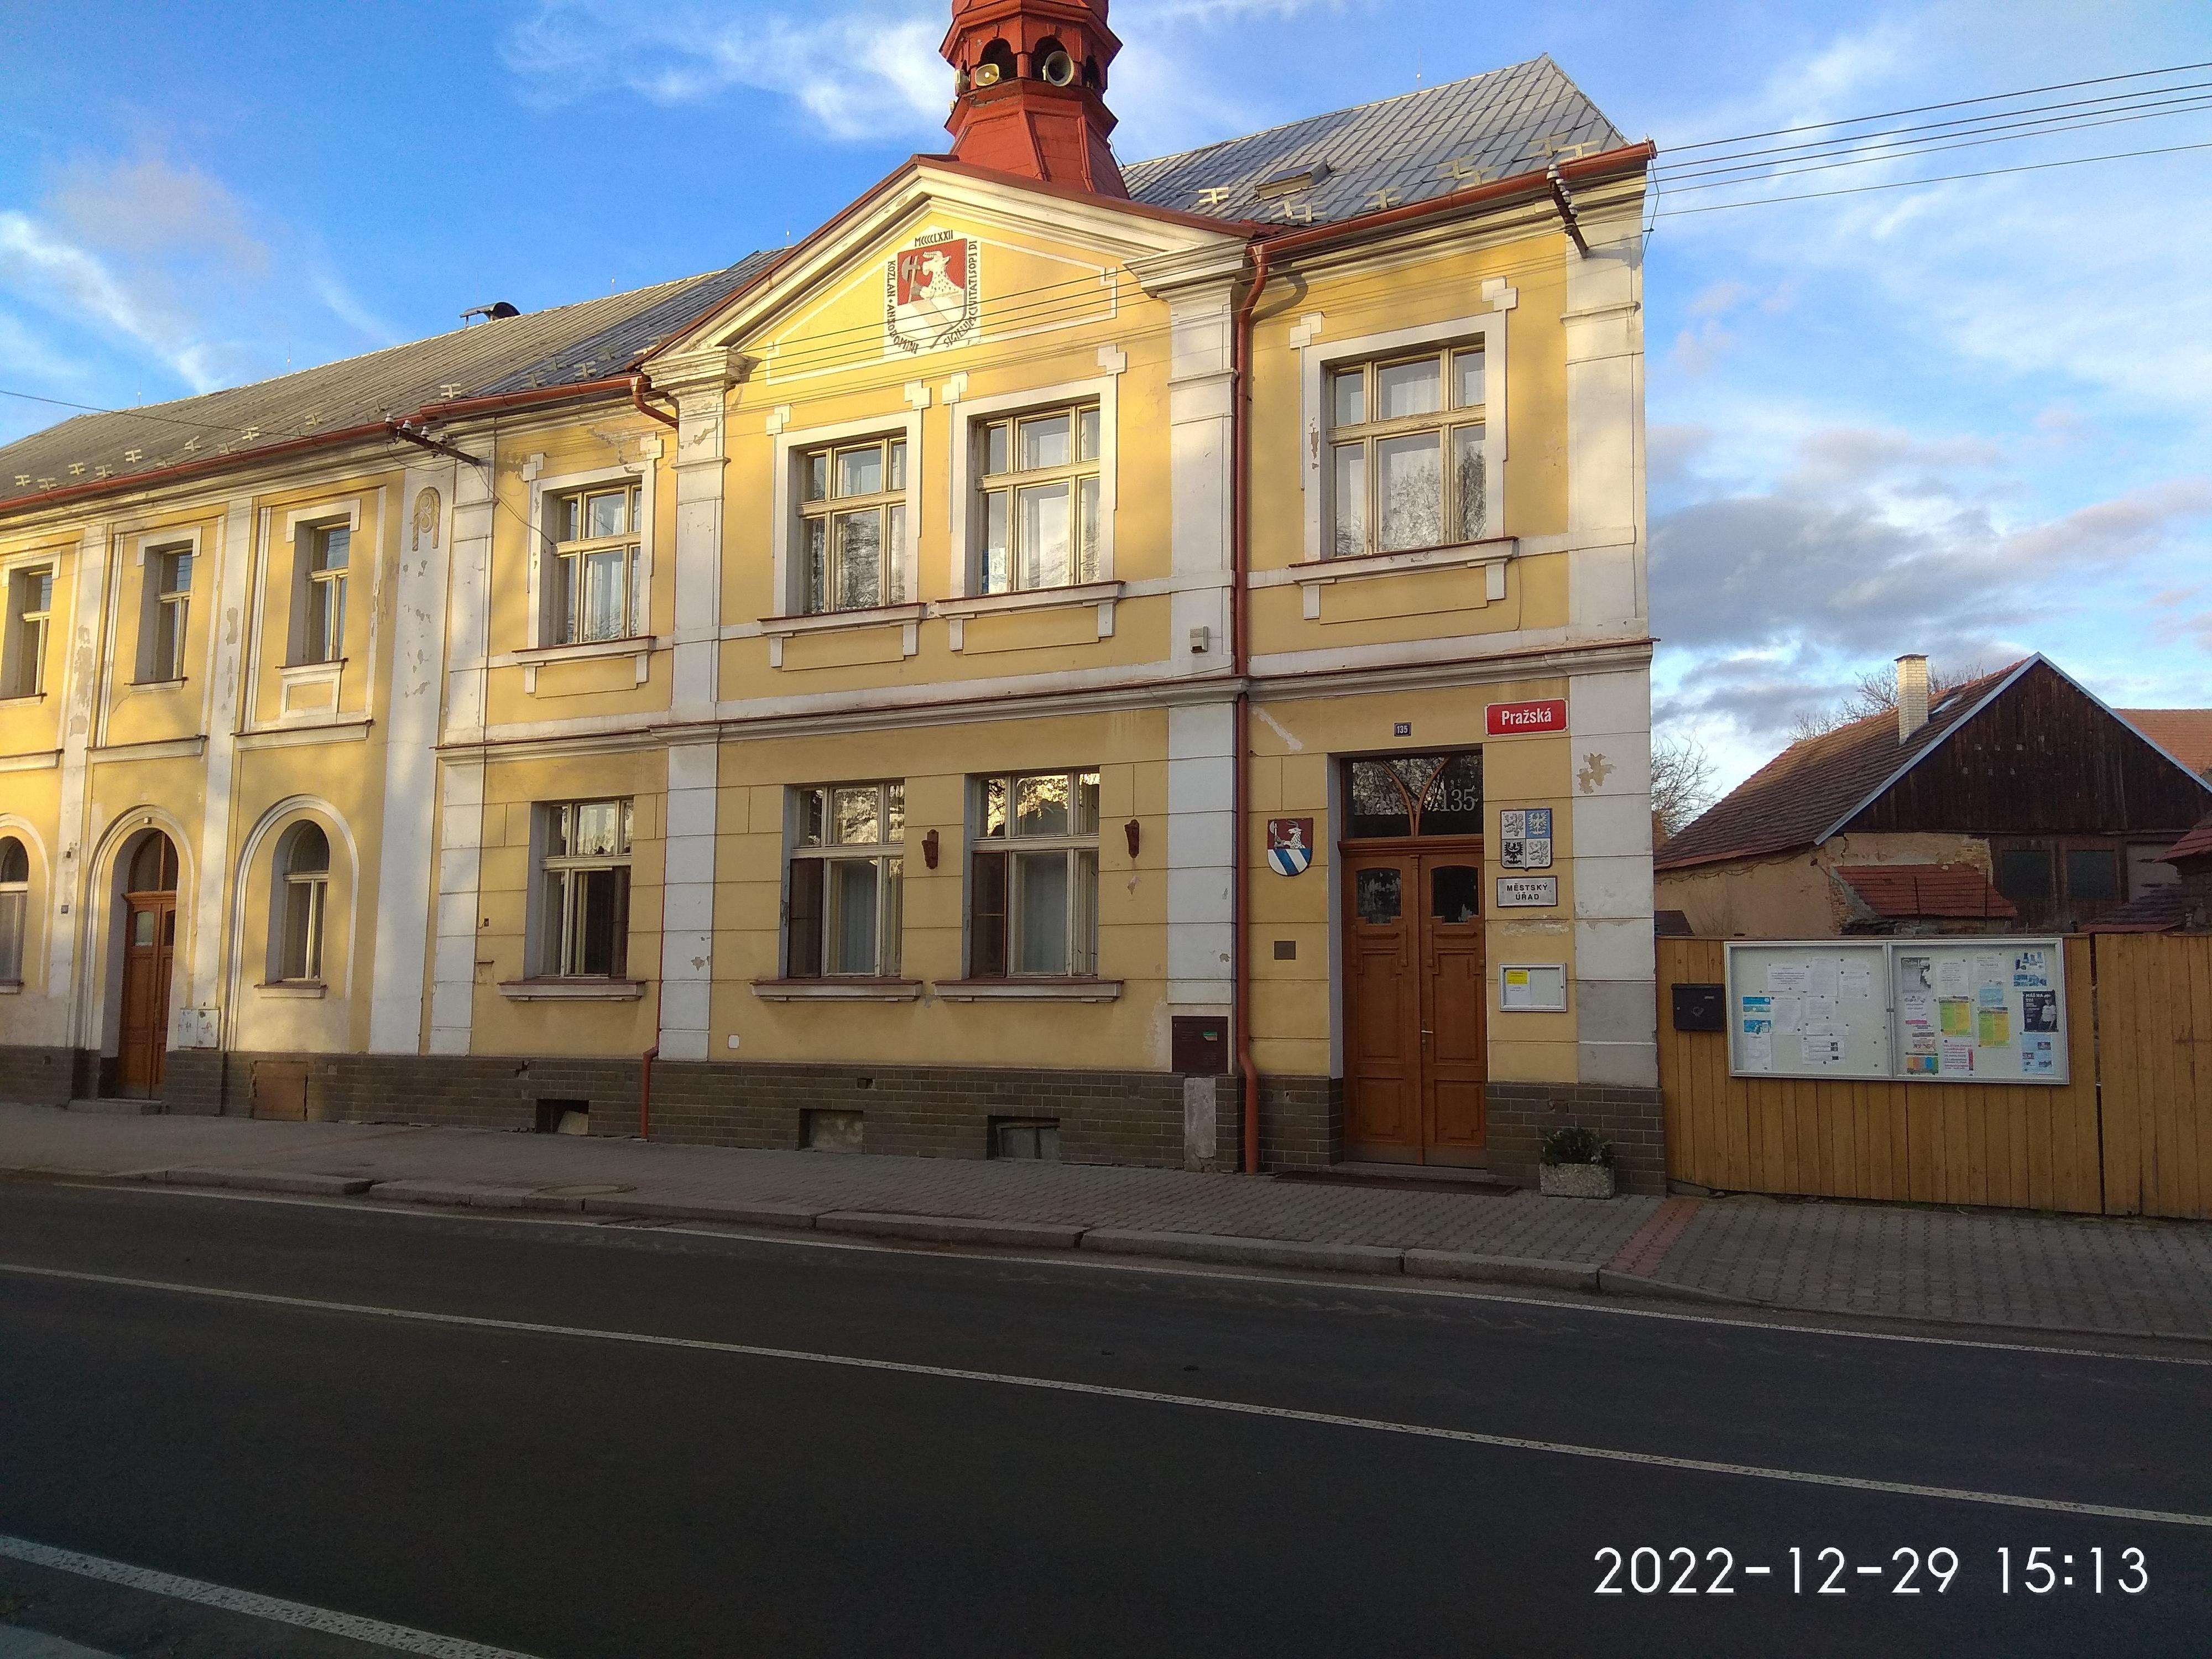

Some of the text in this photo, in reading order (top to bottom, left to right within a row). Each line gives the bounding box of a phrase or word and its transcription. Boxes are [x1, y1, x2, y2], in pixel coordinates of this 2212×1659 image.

[887, 260, 896, 298] KOZLAN
[887, 304, 896, 332] ANNO
[1501, 707, 1552, 726] Pražská
[1396, 725, 1408, 734] 135
[1440, 789, 1476, 812] 135
[1506, 882, 1548, 891] MĚSTSKÝ
[1515, 891, 1540, 900] ÚŘAD
